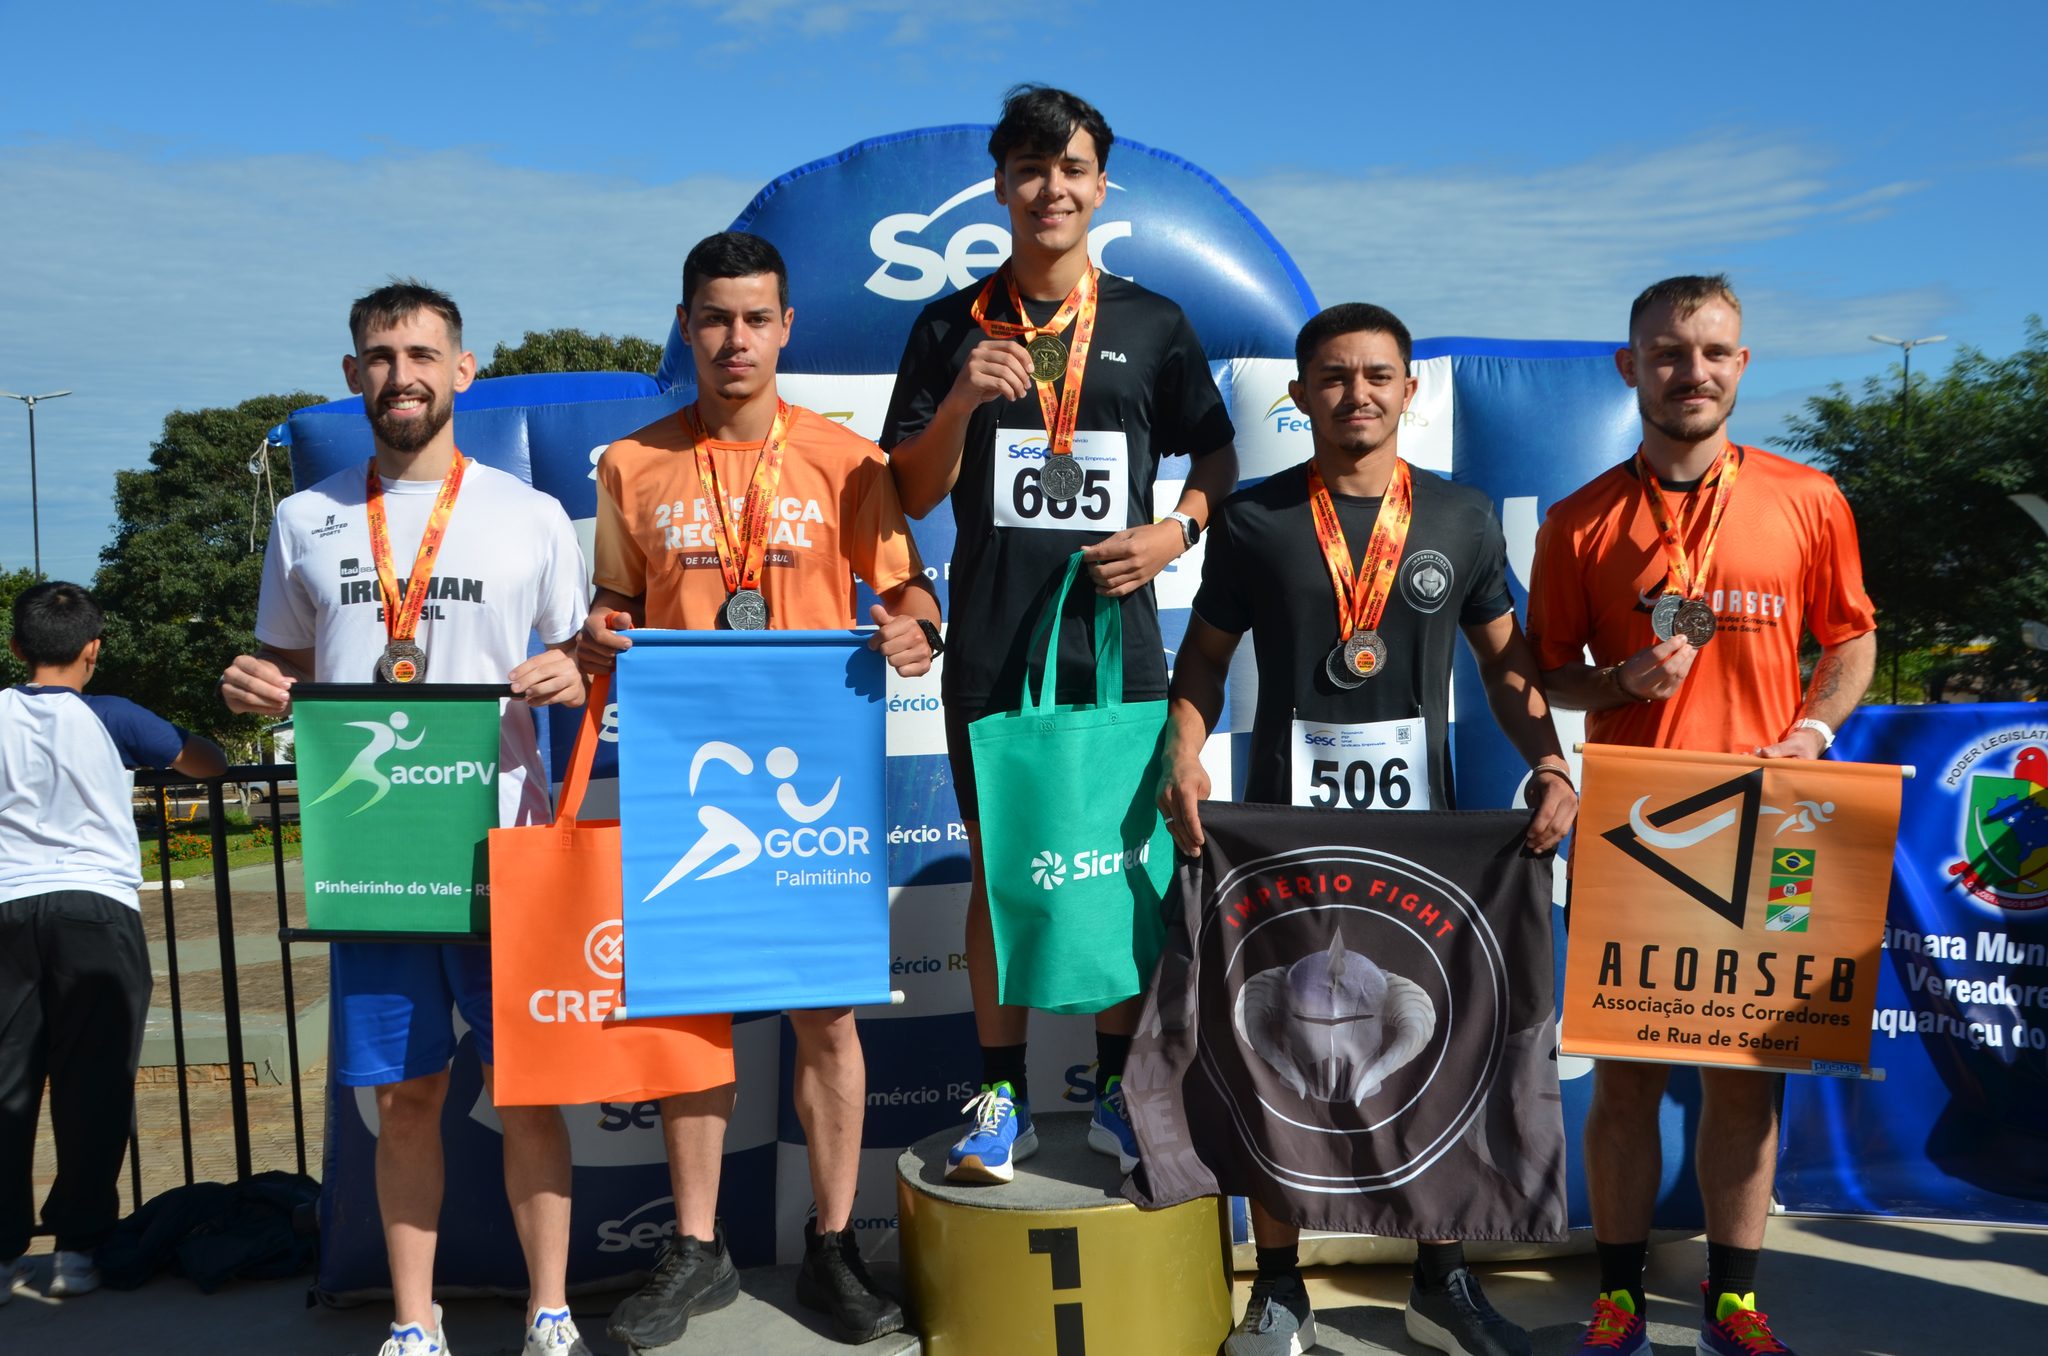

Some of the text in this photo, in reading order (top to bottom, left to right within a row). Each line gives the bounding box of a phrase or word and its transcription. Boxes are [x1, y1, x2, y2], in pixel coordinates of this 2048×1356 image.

[864, 212, 1134, 302] Sec
[1100, 350, 1127, 363] FILA
[311, 522, 348, 535] UNLIMITED
[656, 500, 684, 528] 2ª
[319, 529, 341, 538] SPORTS
[341, 566, 359, 575] Itaú
[686, 557, 699, 565] DE
[772, 554, 789, 563] SUL
[1305, 733, 1336, 747] Sesc
[391, 761, 496, 785] acorPV
[1946, 748, 1981, 786] PODER
[1310, 758, 1411, 810] 506
[764, 826, 870, 858] GCOR
[1073, 838, 1150, 881] Sicredi
[315, 880, 404, 895] Pinheirinho
[407, 881, 427, 895] do
[430, 882, 462, 896] Vale
[776, 868, 871, 887] Palmitinho
[1225, 874, 1454, 938] IMPÉRIO FIGHT
[1976, 931, 2048, 968] Mun
[1598, 942, 1856, 1003] ACORSEB
[1907, 962, 2048, 1010] Vereadore
[529, 989, 625, 1023] CRE
[1592, 993, 1850, 1027] Associação dos Corredores
[1637, 1024, 1799, 1052] de Rua de Seberi
[2011, 1019, 2046, 1050] do
[867, 1081, 974, 1106] mércio RS
